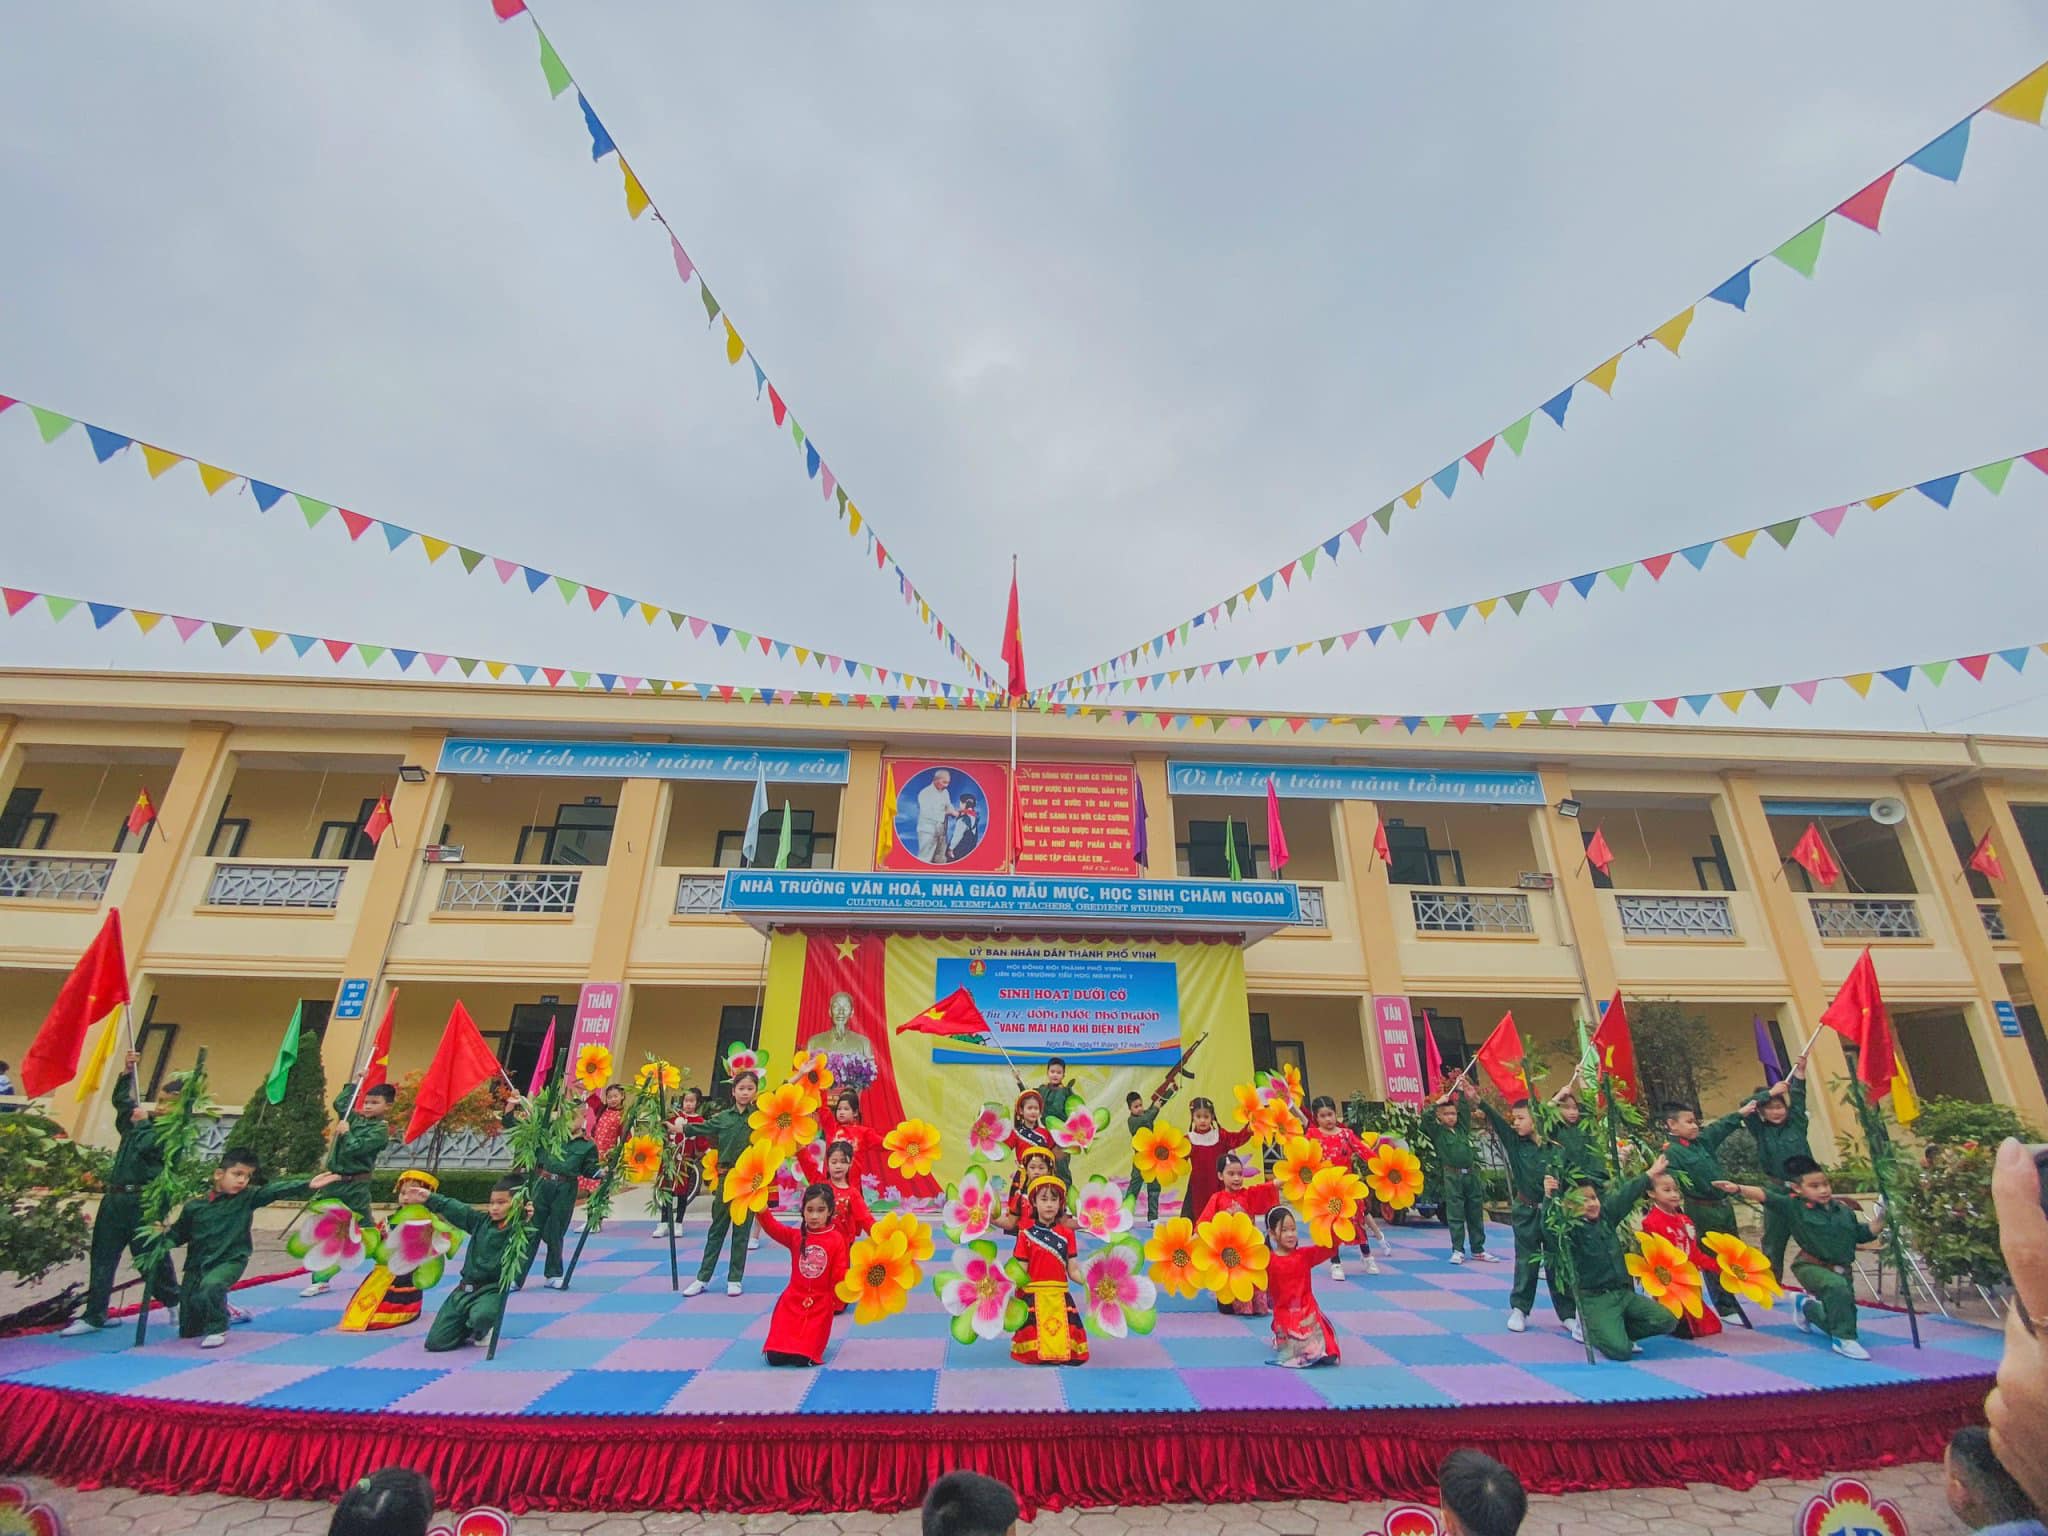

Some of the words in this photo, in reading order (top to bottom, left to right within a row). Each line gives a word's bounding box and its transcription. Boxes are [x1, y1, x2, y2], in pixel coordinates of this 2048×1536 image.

[452, 745, 490, 764] Vì
[496, 747, 532, 770] lợi
[537, 749, 575, 767] ích
[583, 750, 652, 768] mười
[656, 753, 714, 769] năm
[722, 752, 791, 775] trồng
[798, 758, 842, 777] cây
[1175, 768, 1207, 785] Vì
[1215, 769, 1243, 791] lợi
[1250, 771, 1281, 788] ích
[1289, 773, 1344, 789] trăm
[1351, 776, 1400, 791] năm
[1407, 774, 1466, 796] trồng
[1474, 778, 1536, 797] người
[740, 879, 773, 893] NHÀ
[780, 878, 845, 895] TRƯỜNG
[851, 879, 882, 896] VĂN
[889, 880, 926, 898] HOÁ,
[932, 880, 964, 897] NHÀ
[969, 881, 1007, 898] GIÁO
[1012, 881, 1048, 899] MẪU
[1053, 886, 1095, 902] MỰC,
[1100, 887, 1132, 903] HỌC
[1138, 888, 1175, 902] SINH
[1179, 888, 1228, 904] CHĂM
[1231, 891, 1285, 905] NGOAN
[846, 898, 902, 907] CULTURAL
[904, 899, 947, 909] SCHOOL,
[950, 900, 1014, 910] EXEMPLARY
[1018, 902, 1074, 912] TEACHERS,
[1076, 903, 1129, 912] OBEDIENT
[1130, 904, 1184, 913] STUDENTS
[986, 948, 1007, 957] BAN
[1010, 947, 1041, 958] NHÂN
[1043, 947, 1066, 958] DÂN
[1069, 947, 1103, 959] THÀNH
[1107, 947, 1129, 959] PHỐ
[1131, 950, 1157, 959] VINH
[587, 991, 613, 1008] THÂN
[999, 989, 1031, 999] SINH
[1034, 989, 1070, 1003] HOẠT
[1073, 988, 1106, 1001] DƯỚI
[1109, 987, 1127, 1001] CỜ
[581, 1015, 610, 1037] THIỆN
[1072, 1022, 1089, 1034] KHÍ
